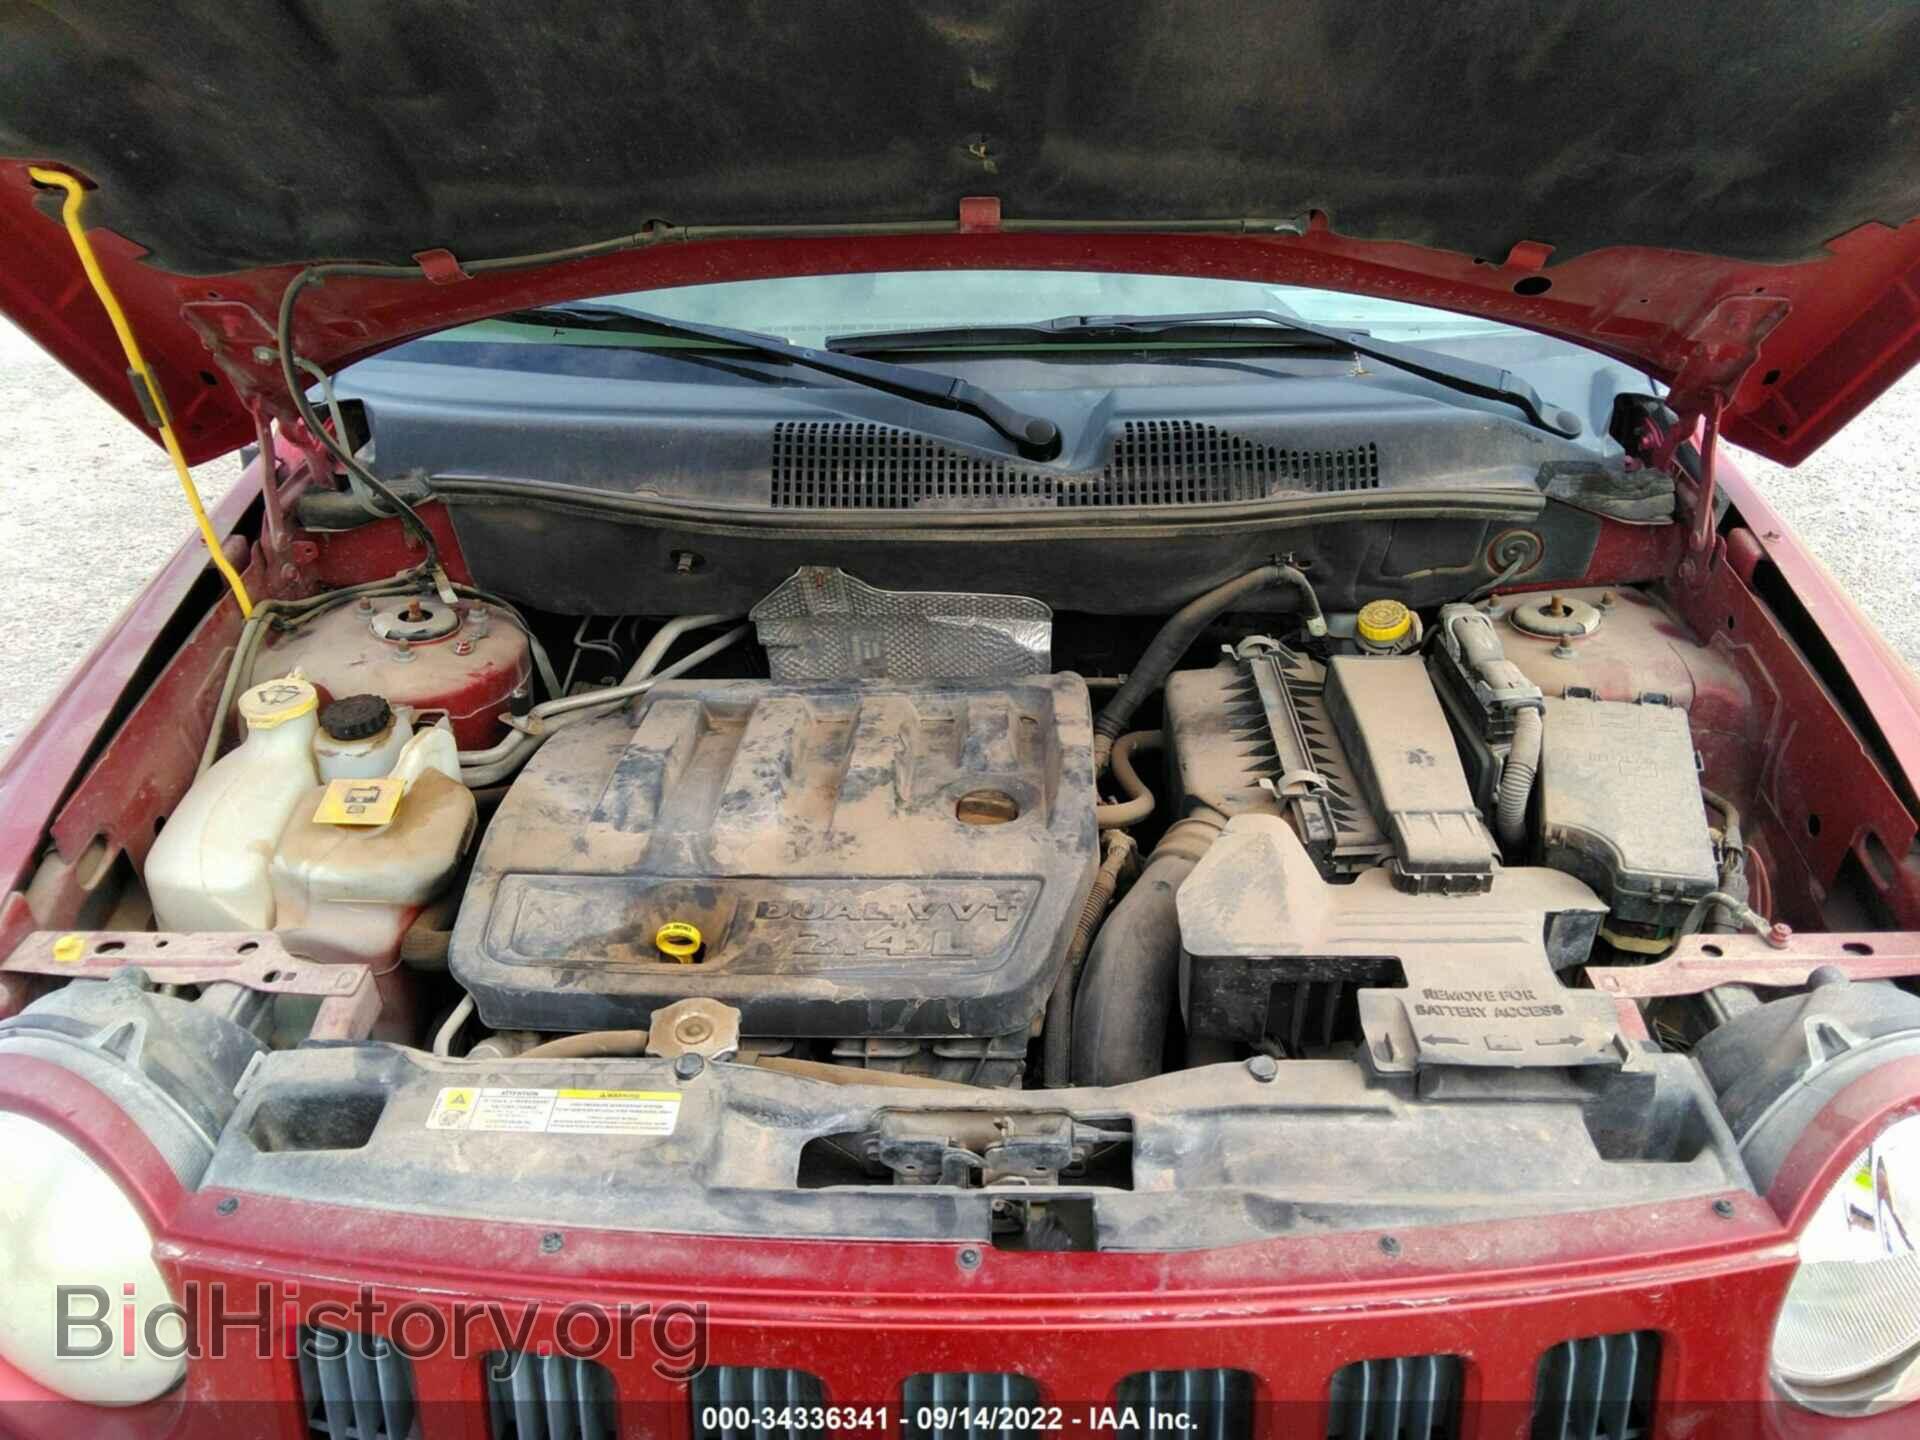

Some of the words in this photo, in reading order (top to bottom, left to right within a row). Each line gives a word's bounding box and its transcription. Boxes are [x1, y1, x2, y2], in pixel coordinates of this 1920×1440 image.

[755, 900, 894, 921] DUAL
[907, 901, 1017, 922] VVT
[1422, 988, 1495, 1001] REMOVE
[1499, 989, 1536, 1001] FOR
[1415, 1004, 1486, 1018] BATTERY
[1494, 1004, 1564, 1018] ACCESS
